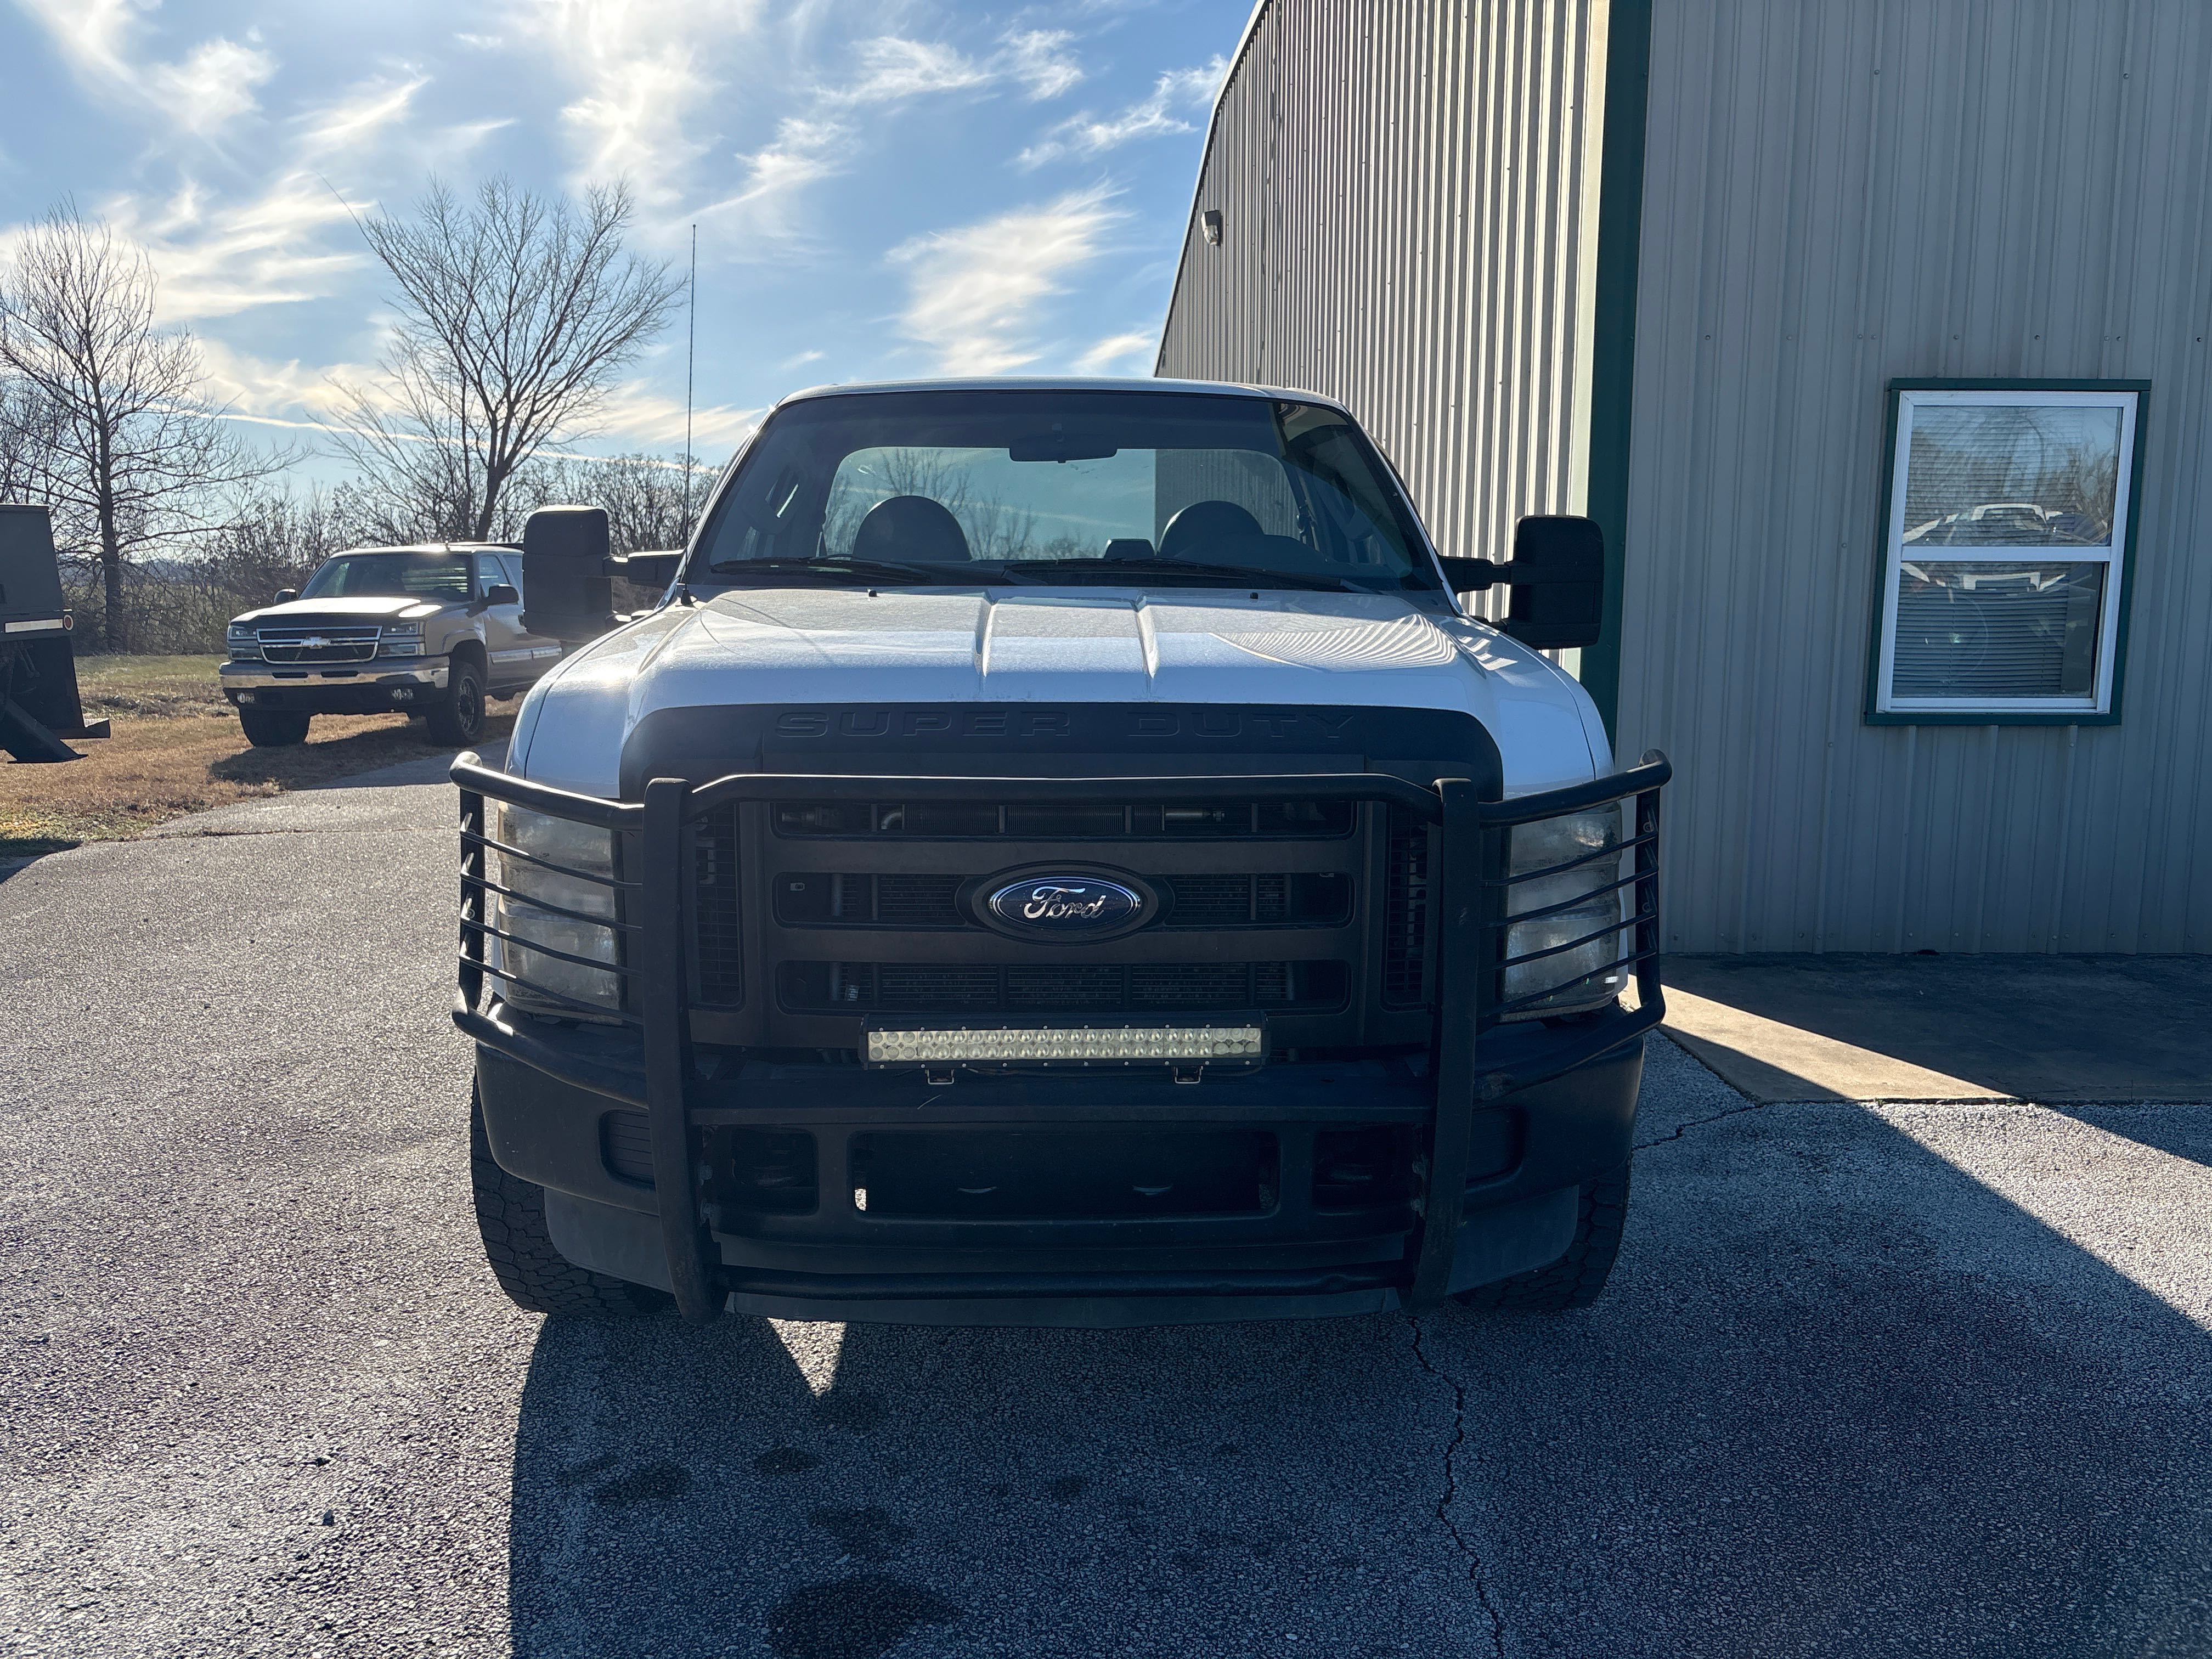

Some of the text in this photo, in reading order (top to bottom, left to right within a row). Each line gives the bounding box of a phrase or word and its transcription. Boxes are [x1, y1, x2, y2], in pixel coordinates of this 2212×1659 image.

[774, 712, 1356, 738] SUPER DUTY
[1024, 885, 1107, 919] Ford
